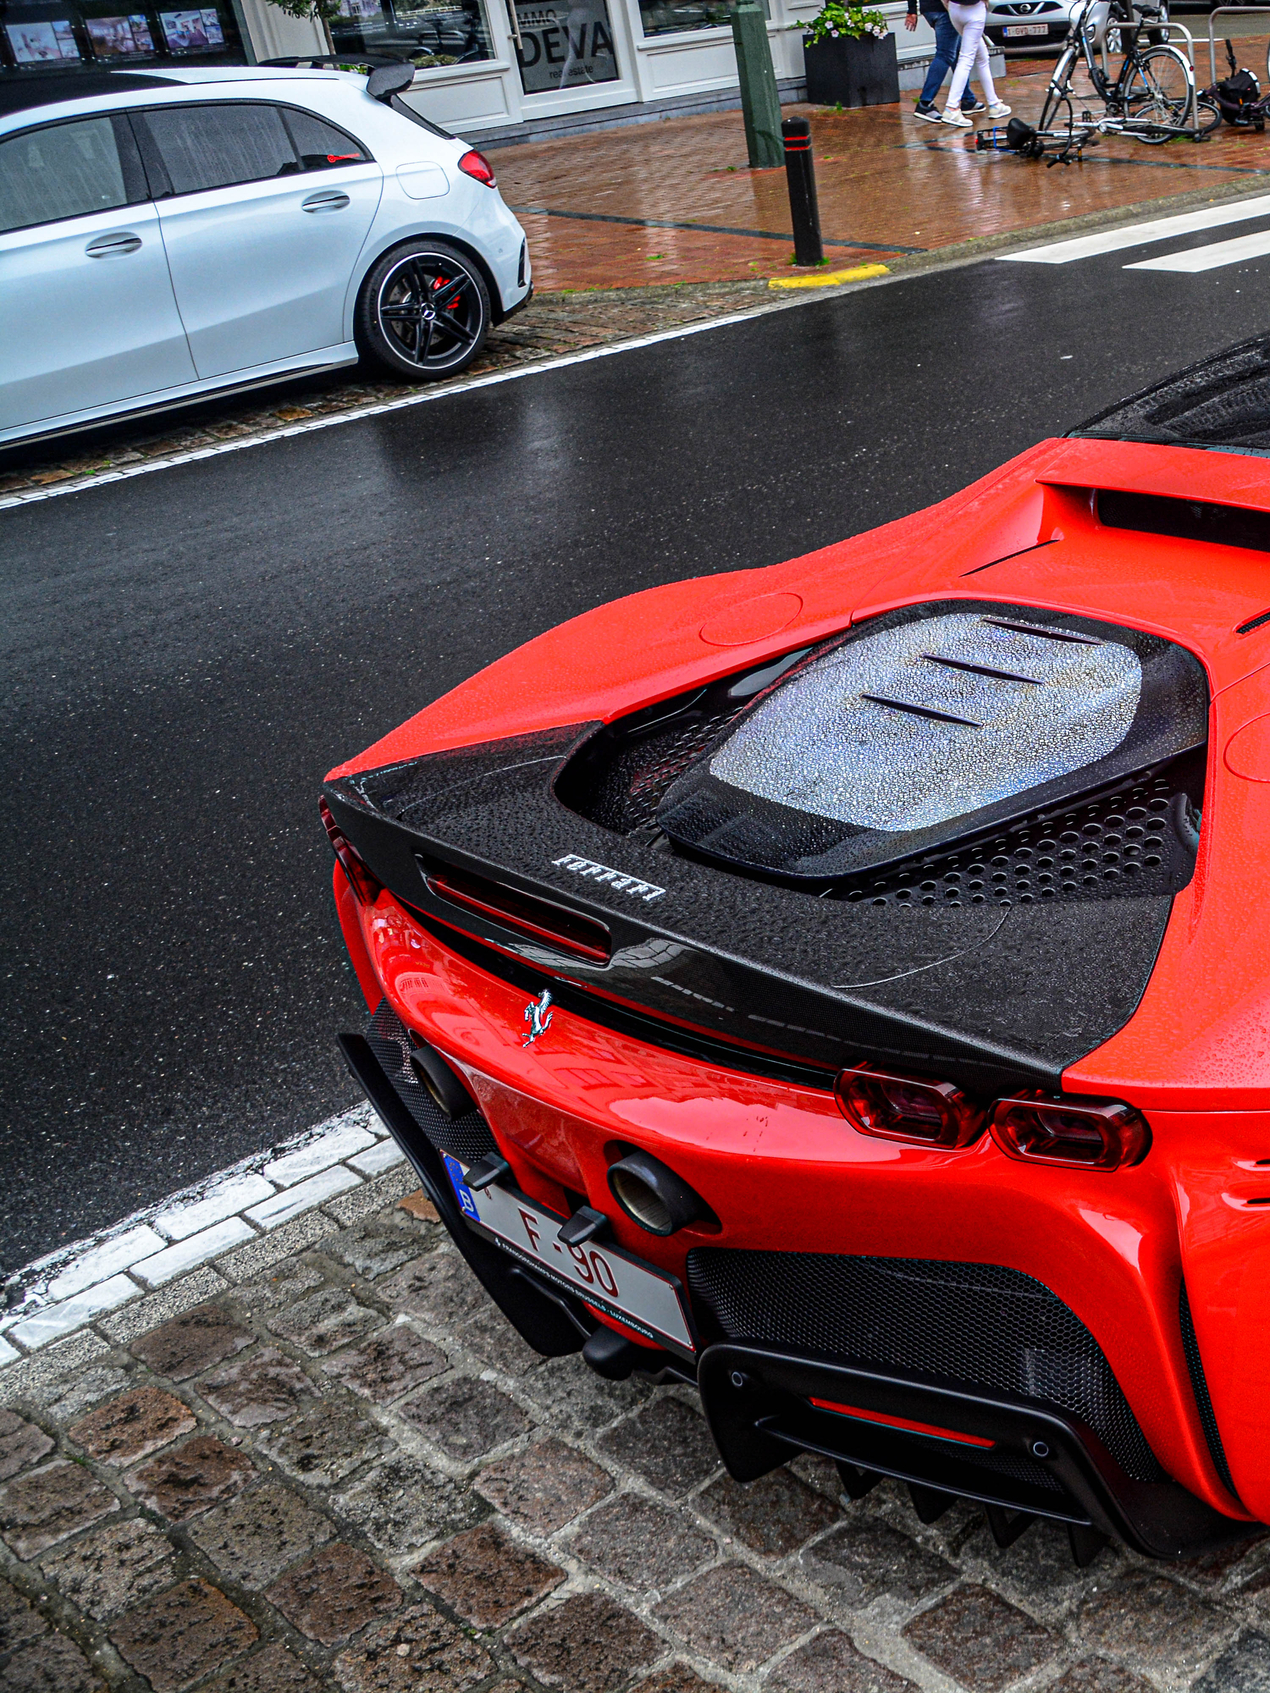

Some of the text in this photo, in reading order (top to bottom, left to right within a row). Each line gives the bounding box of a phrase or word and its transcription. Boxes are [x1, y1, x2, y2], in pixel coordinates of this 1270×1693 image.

[517, 21, 614, 69] DEVA
[552, 853, 667, 902] Ferrari
[459, 1189, 474, 1213] B
